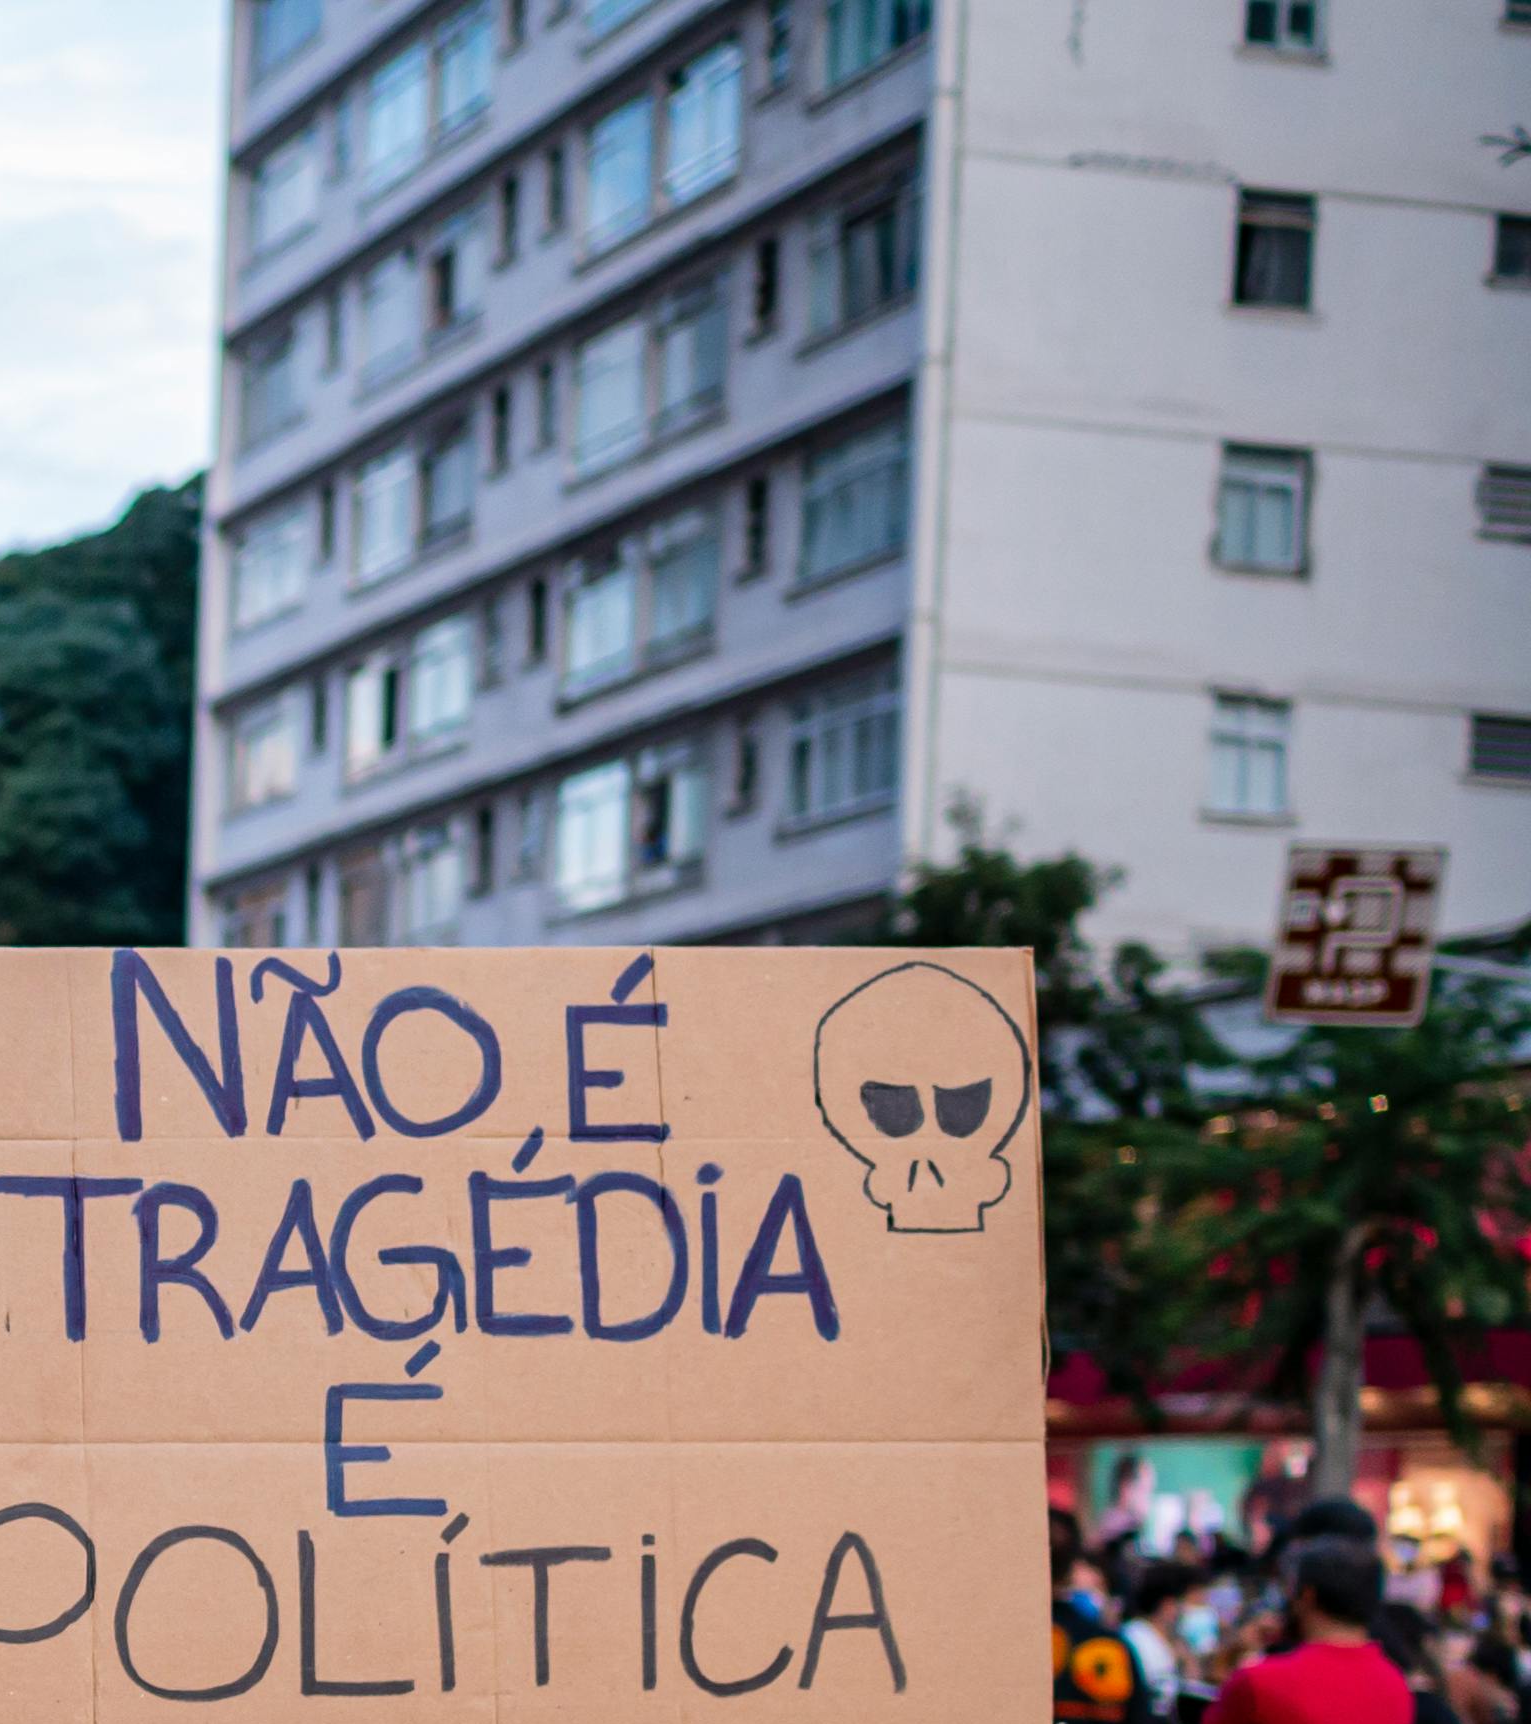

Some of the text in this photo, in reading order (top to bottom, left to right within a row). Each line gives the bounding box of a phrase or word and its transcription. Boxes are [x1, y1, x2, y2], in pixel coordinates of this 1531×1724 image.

[111, 948, 670, 1142] NÃO É
[326, 1342, 447, 1517] É
